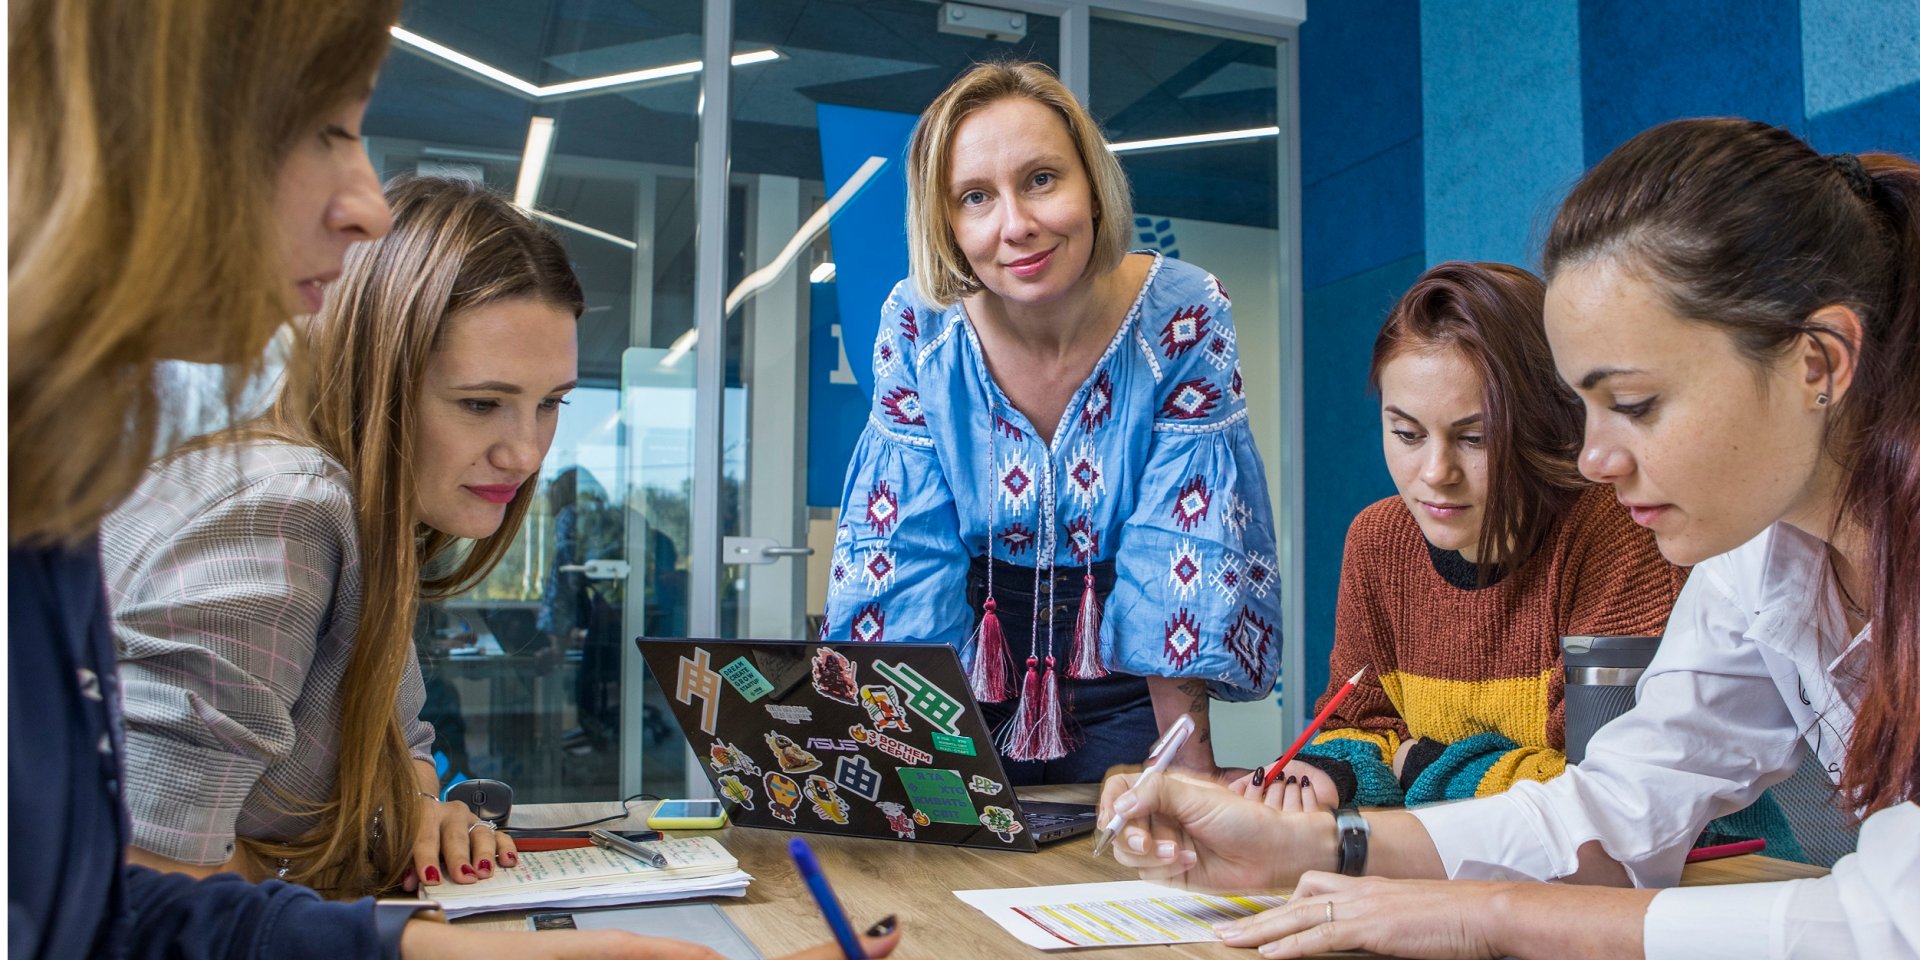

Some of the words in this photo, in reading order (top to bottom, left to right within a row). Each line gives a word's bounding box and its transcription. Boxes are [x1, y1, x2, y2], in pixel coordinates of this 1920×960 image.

[723, 661, 745, 676] DREAM
[729, 667, 750, 681] CREATE
[734, 672, 754, 686] GROW
[739, 678, 759, 692] STARTUP
[806, 737, 860, 752] ASUS
[880, 735, 931, 763] ВОГНЕМ
[879, 744, 915, 764] СЕРЦІ
